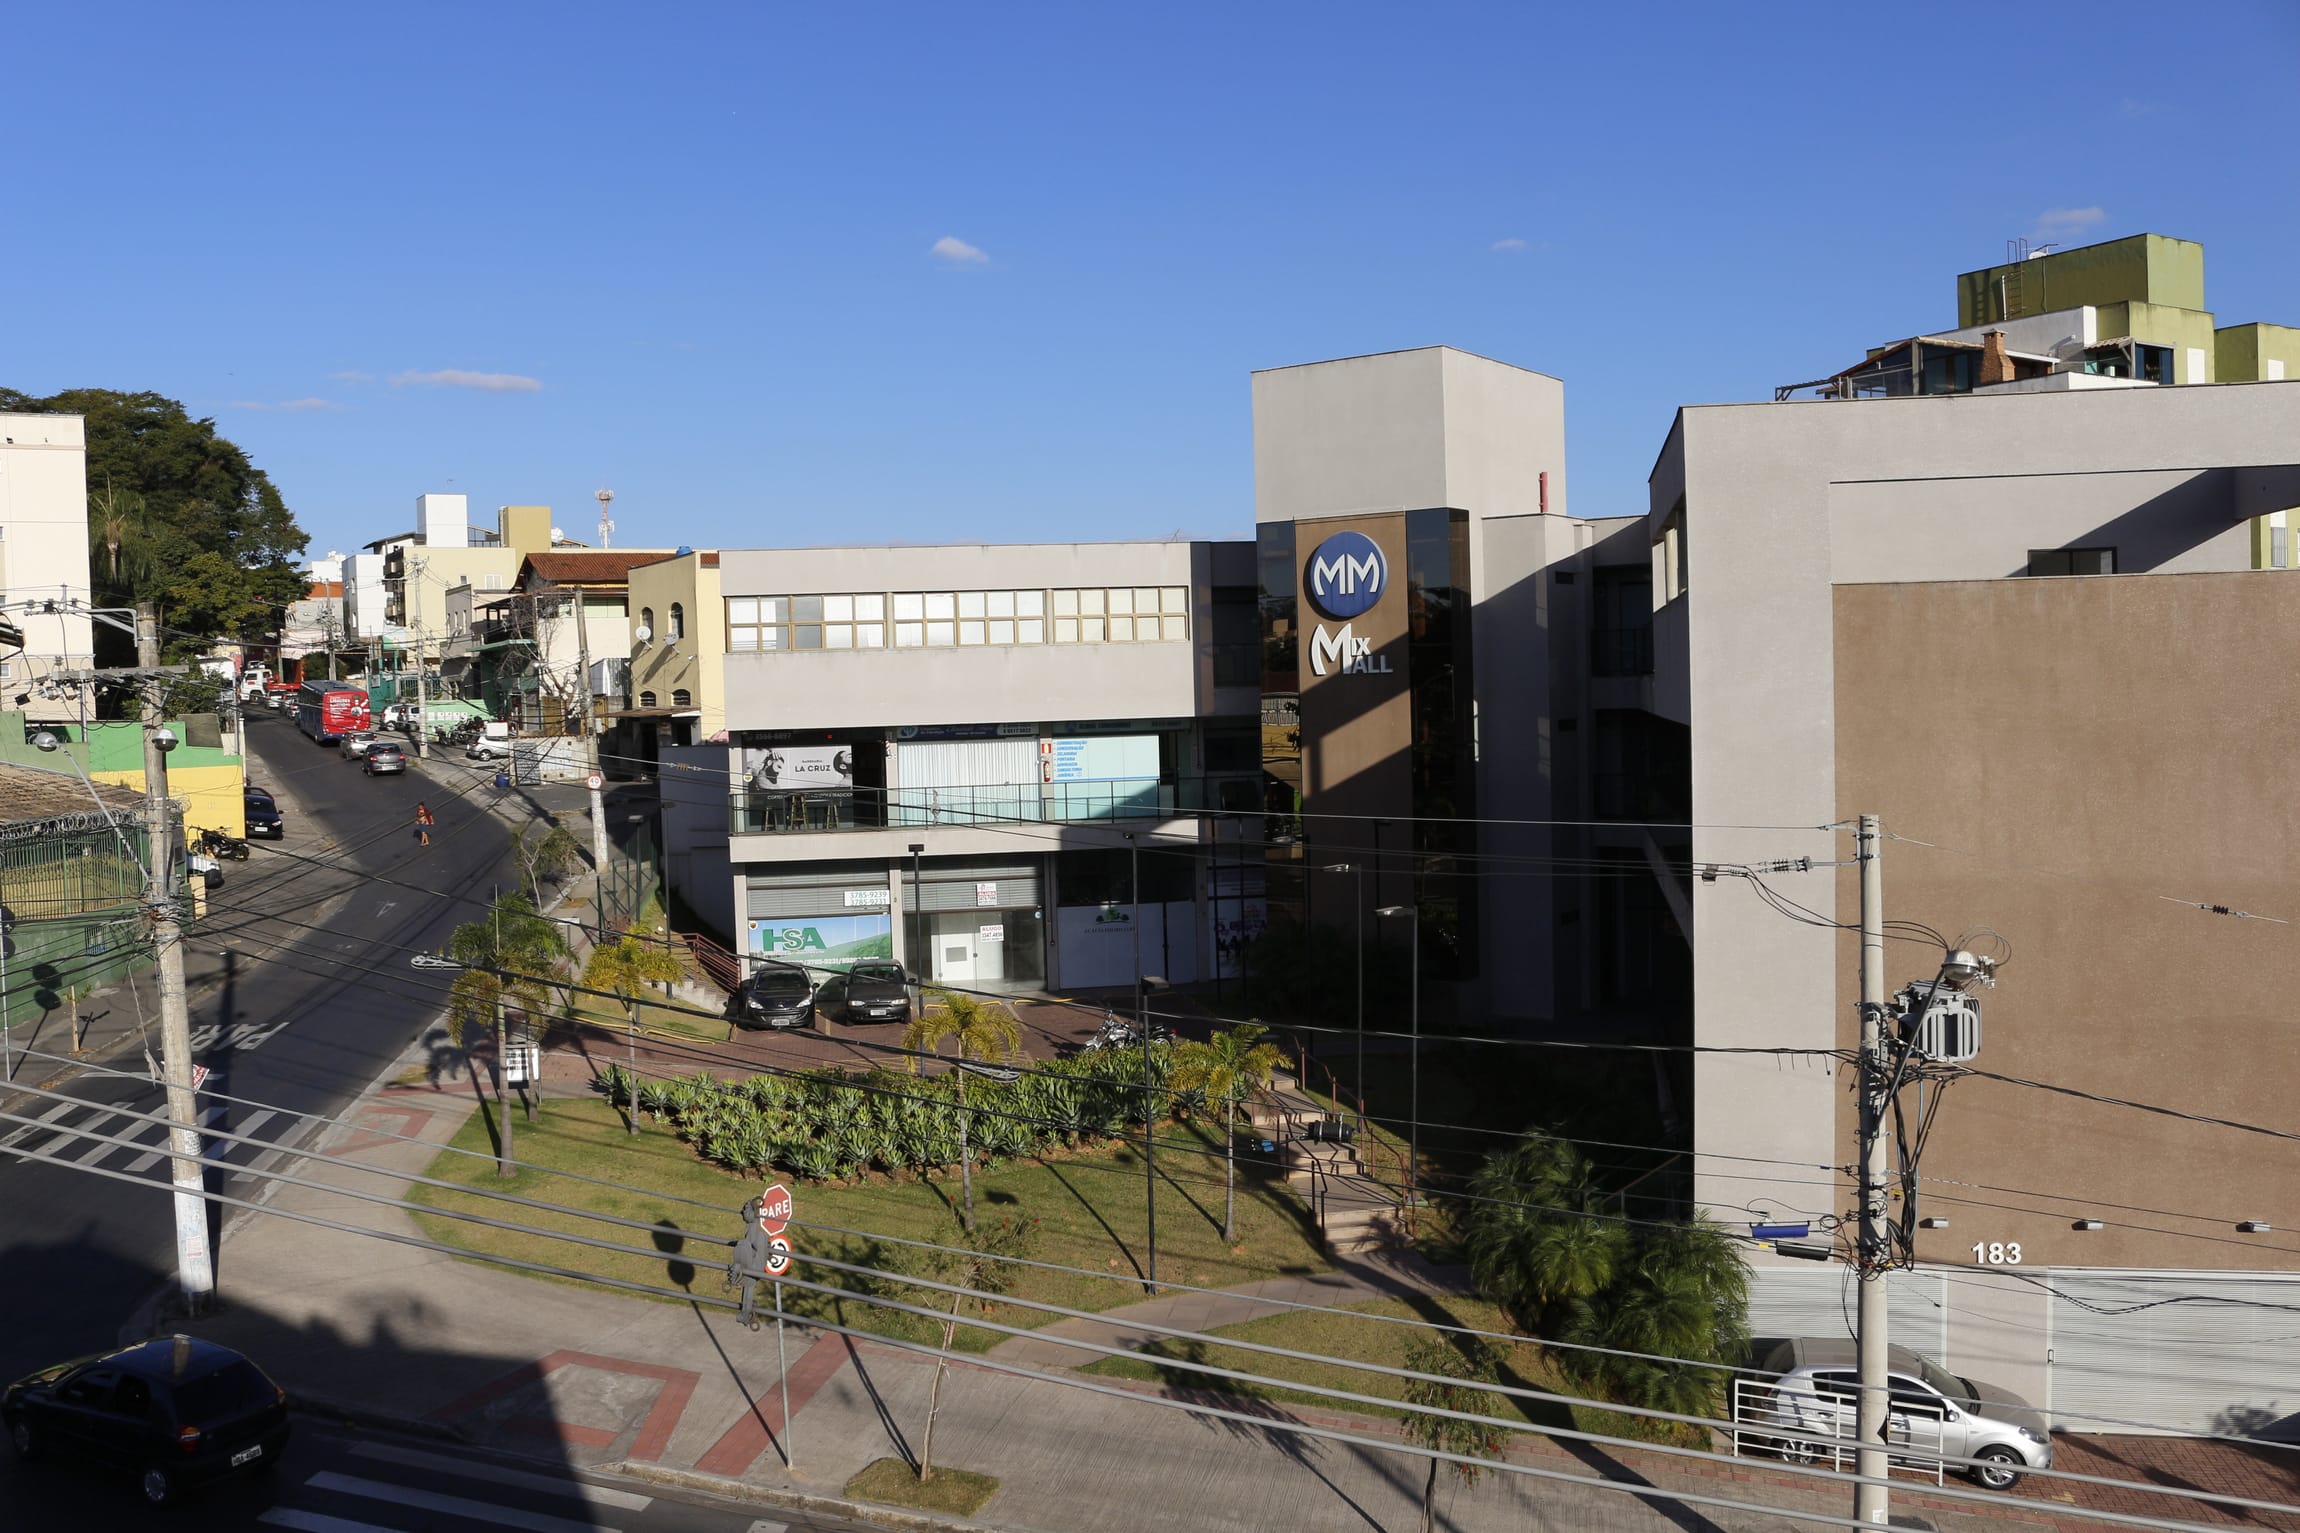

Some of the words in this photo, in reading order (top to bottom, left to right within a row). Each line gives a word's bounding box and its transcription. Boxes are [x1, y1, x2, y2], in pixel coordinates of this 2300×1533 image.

[1314, 552, 1380, 596] MM
[795, 765, 805, 773] LA
[808, 764, 831, 772] CRUZ
[762, 927, 827, 952] HSA
[762, 1199, 789, 1222] PARE
[1971, 1241, 2022, 1265] 183
